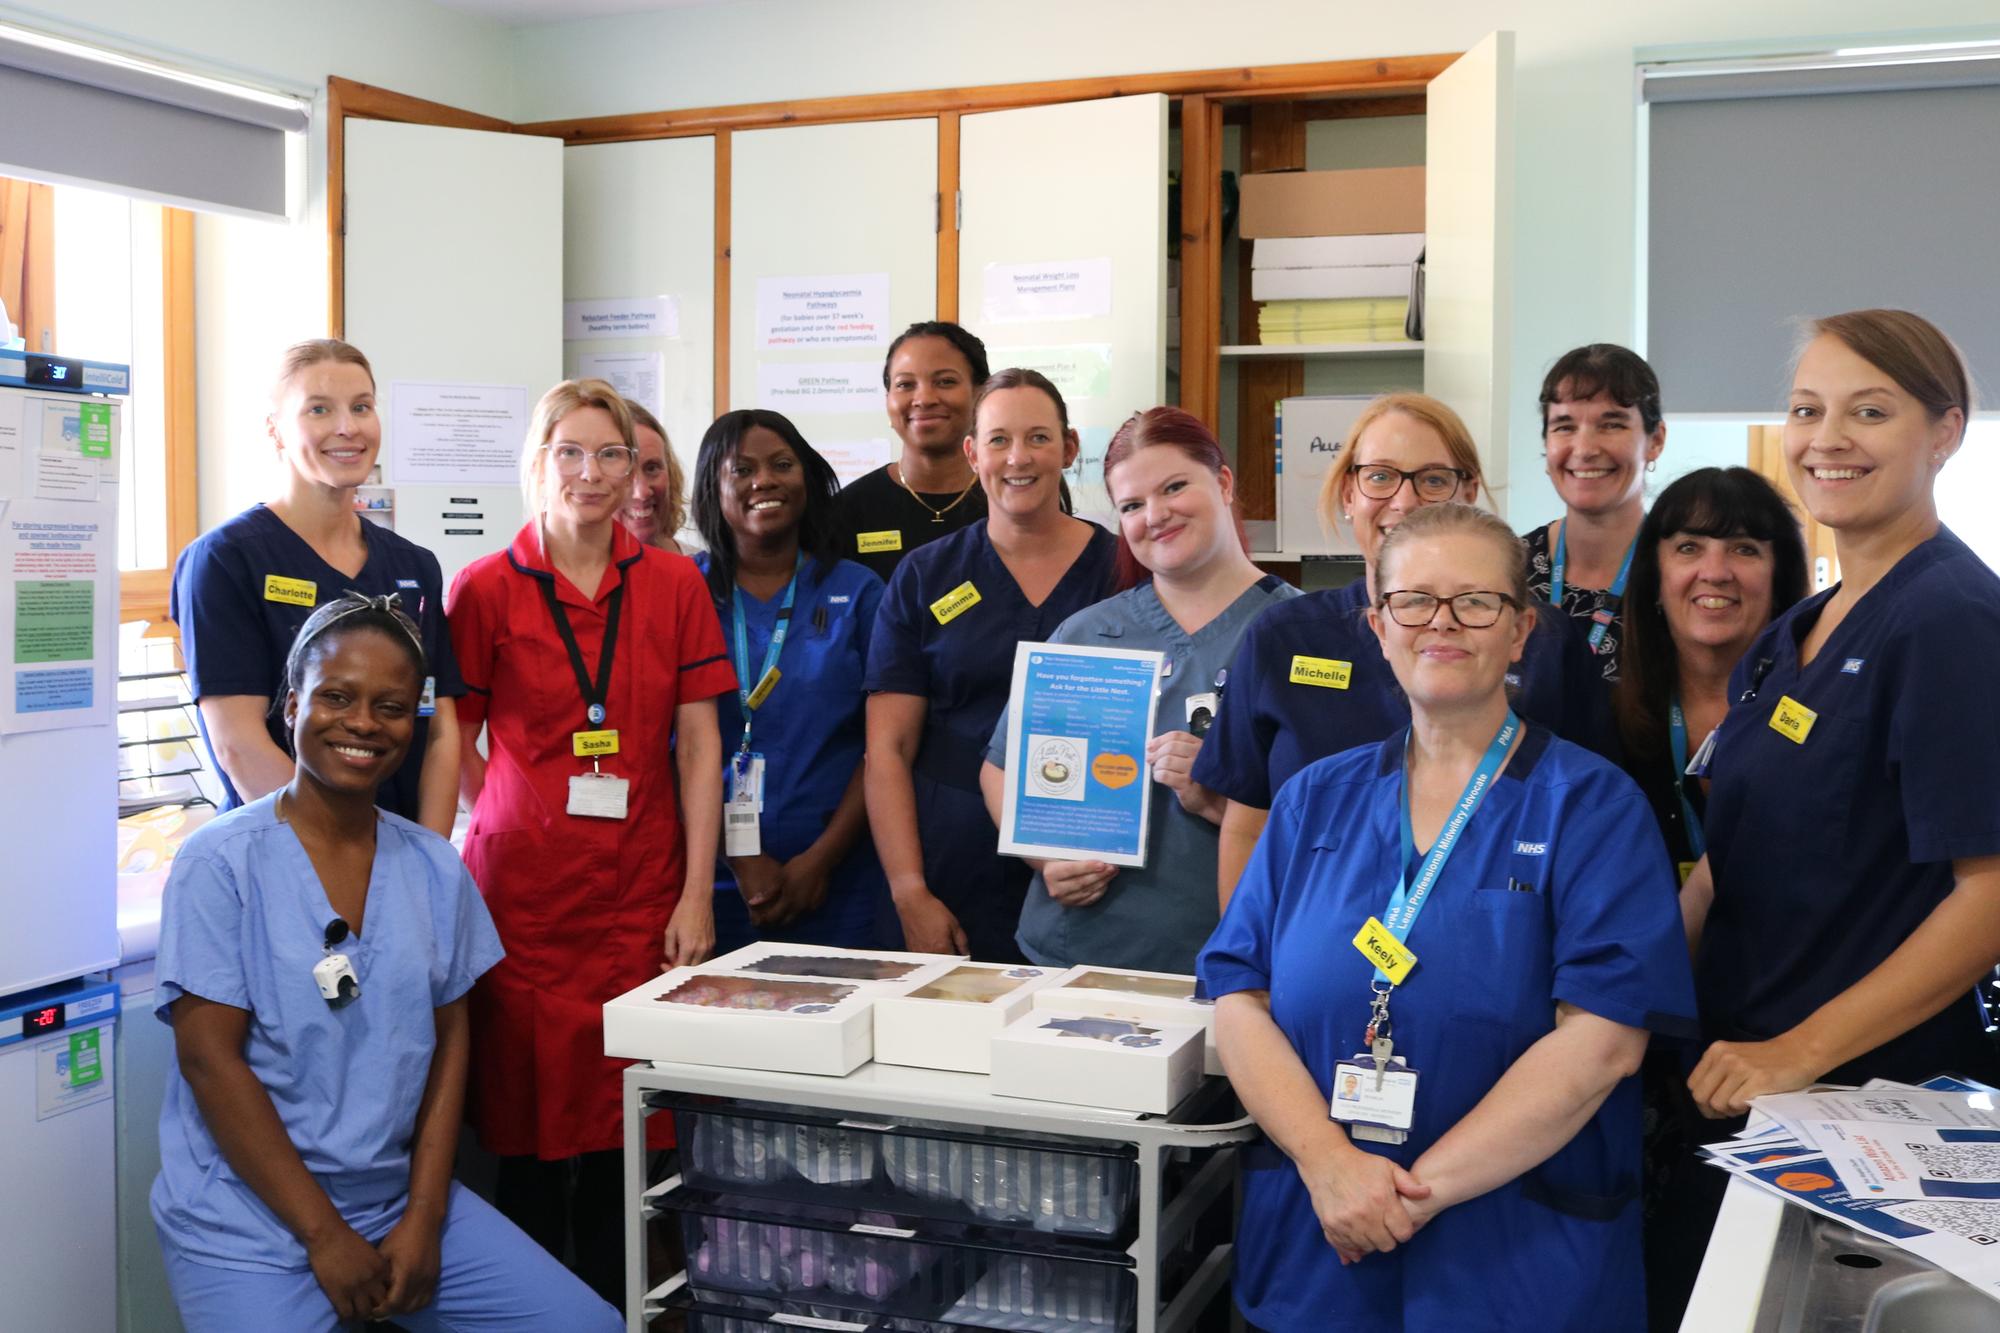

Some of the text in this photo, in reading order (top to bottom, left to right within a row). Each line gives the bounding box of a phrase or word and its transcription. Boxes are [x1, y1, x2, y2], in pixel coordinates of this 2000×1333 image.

[1013, 272, 1079, 281] Neonatal Weight Loss
[783, 289, 861, 298] Neonatal Hypoglycaemia
[1017, 283, 1075, 293] Management Plans
[610, 313, 629, 321] Feeder
[780, 314, 792, 322] (for
[794, 312, 814, 321] babies
[841, 311, 863, 320] week's
[588, 324, 612, 332] (healthy
[628, 322, 650, 331] babies)
[771, 324, 800, 333] gestation
[802, 324, 814, 332] and
[825, 323, 836, 331] the
[837, 322, 849, 330] red
[850, 321, 874, 331] feeding
[768, 337, 796, 345] pathway
[833, 334, 877, 343] symptomatic)
[799, 377, 849, 385] GREEN Pathway
[861, 538, 898, 548] Jennifer
[268, 585, 313, 600] Charlotte
[940, 592, 974, 616] Gemma
[1036, 672, 1054, 680] Have
[1070, 674, 1104, 683] forgotten
[1105, 678, 1146, 687] something?
[1295, 667, 1346, 682] Michelle
[1498, 725, 1515, 746] PMA
[582, 740, 612, 749] Sasha
[1399, 772, 1489, 930] Lead Professional Midwifery Advocate
[1517, 843, 1546, 854] NHS
[1366, 935, 1398, 970] Keely
